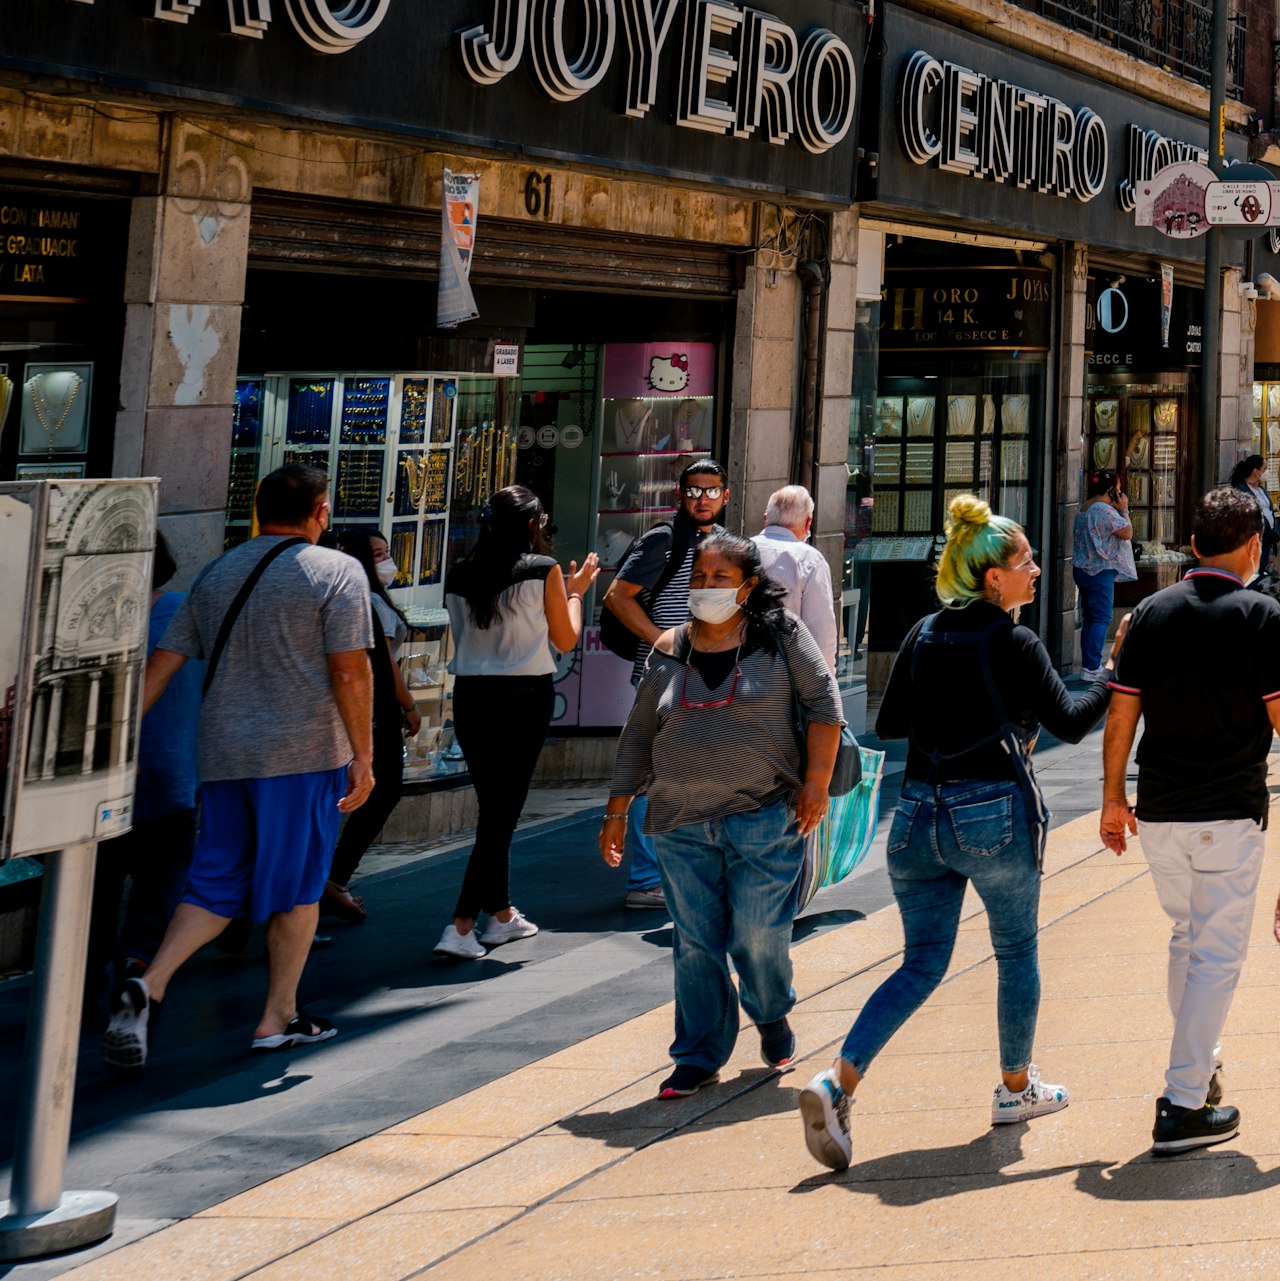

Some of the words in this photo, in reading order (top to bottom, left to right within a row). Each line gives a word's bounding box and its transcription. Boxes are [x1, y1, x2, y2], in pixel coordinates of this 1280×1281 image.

[902, 50, 1108, 203] CENTRO
[524, 171, 551, 217] 61
[933, 288, 979, 303] ORO
[1006, 278, 1050, 303] JOYAS
[495, 348, 518, 356] GRABADO
